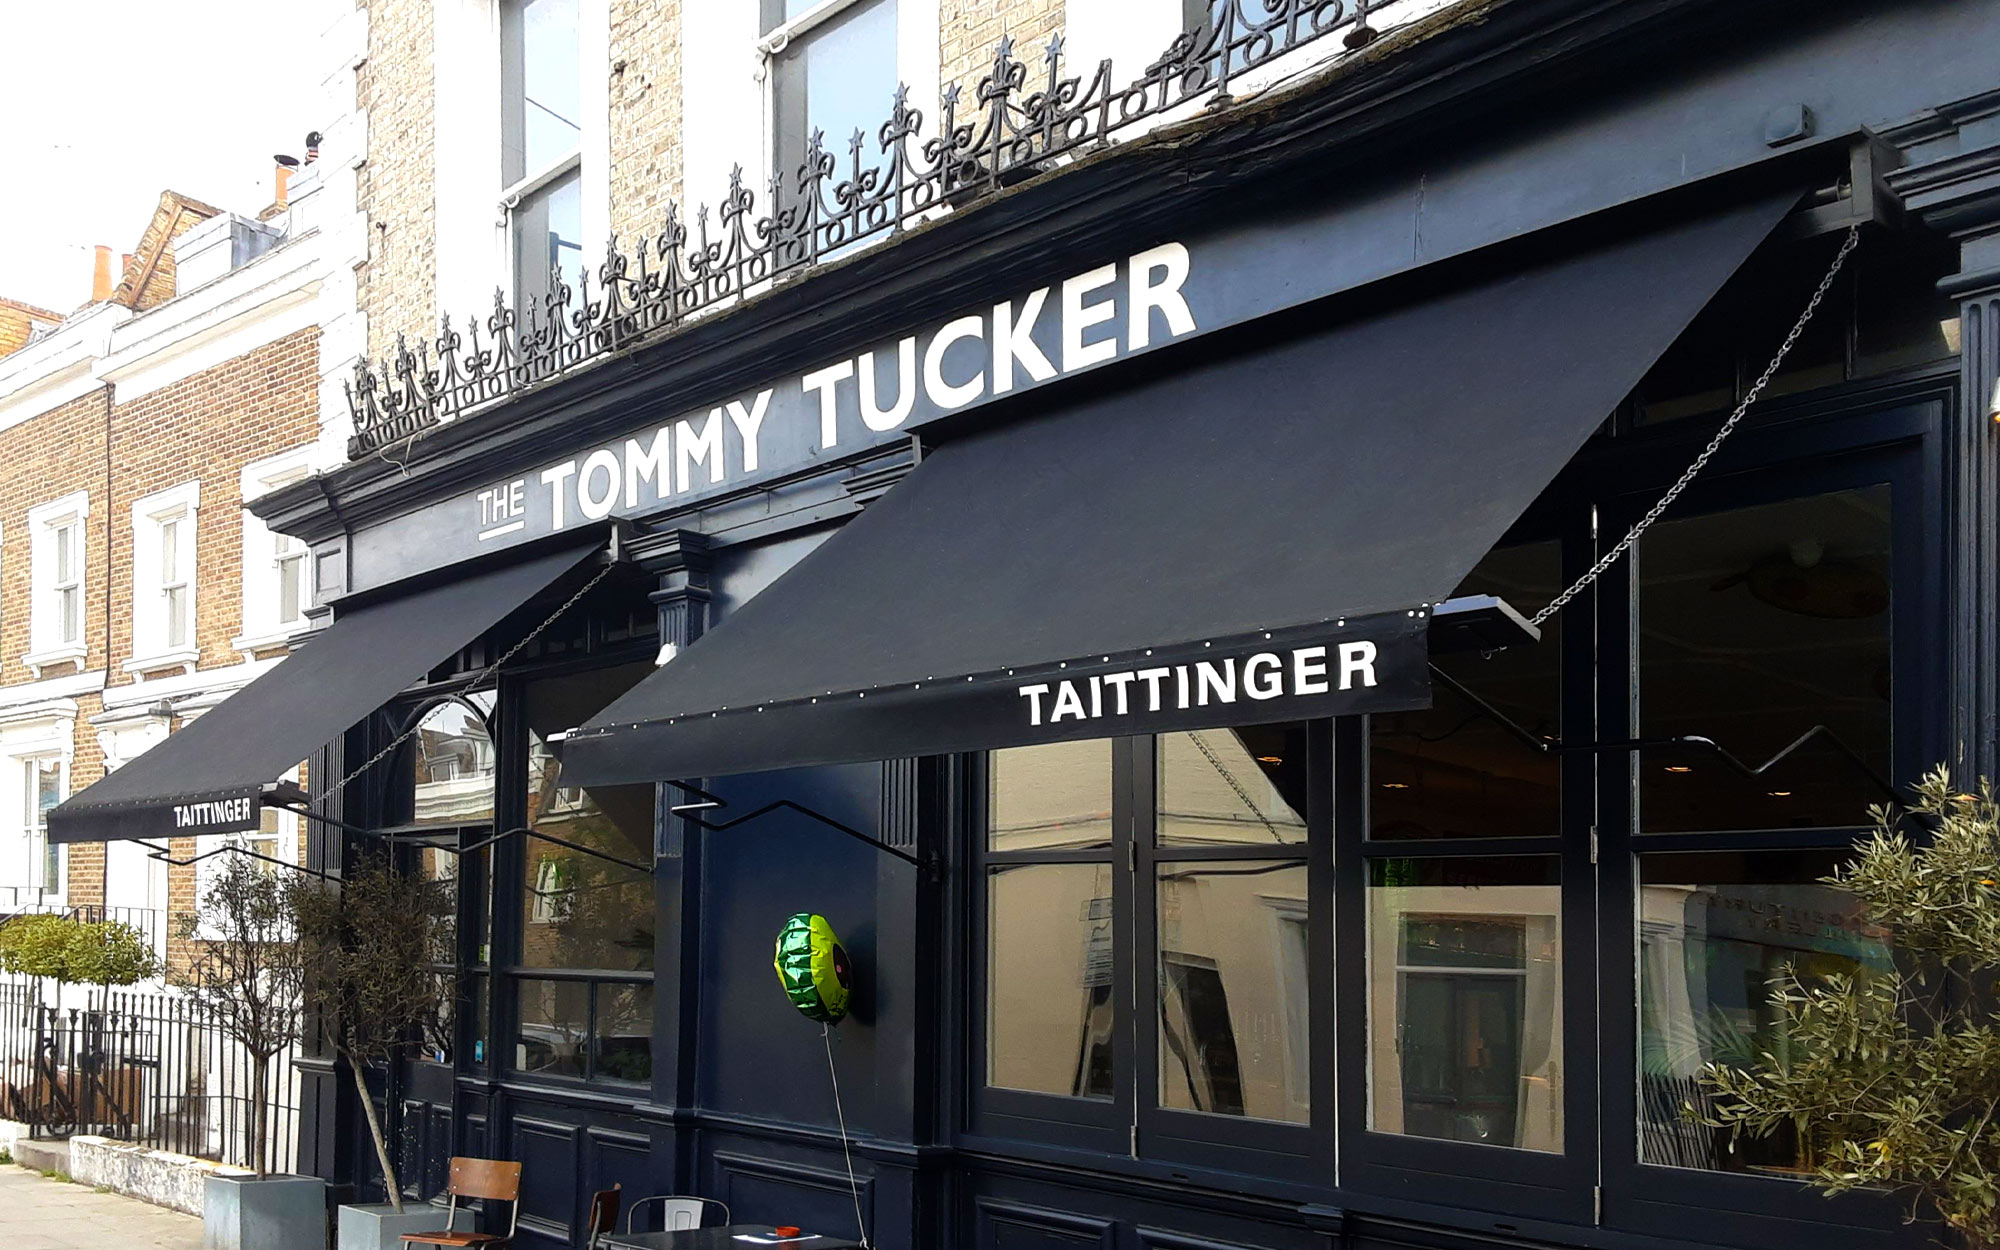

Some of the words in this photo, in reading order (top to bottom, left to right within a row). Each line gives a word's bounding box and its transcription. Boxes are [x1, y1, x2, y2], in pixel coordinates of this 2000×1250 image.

[477, 479, 525, 526] THE
[540, 388, 774, 531] TOMMY
[802, 242, 1197, 449] TUCKER
[1019, 640, 1377, 726] TAITTINGER
[173, 797, 251, 828] TAITTINGER
